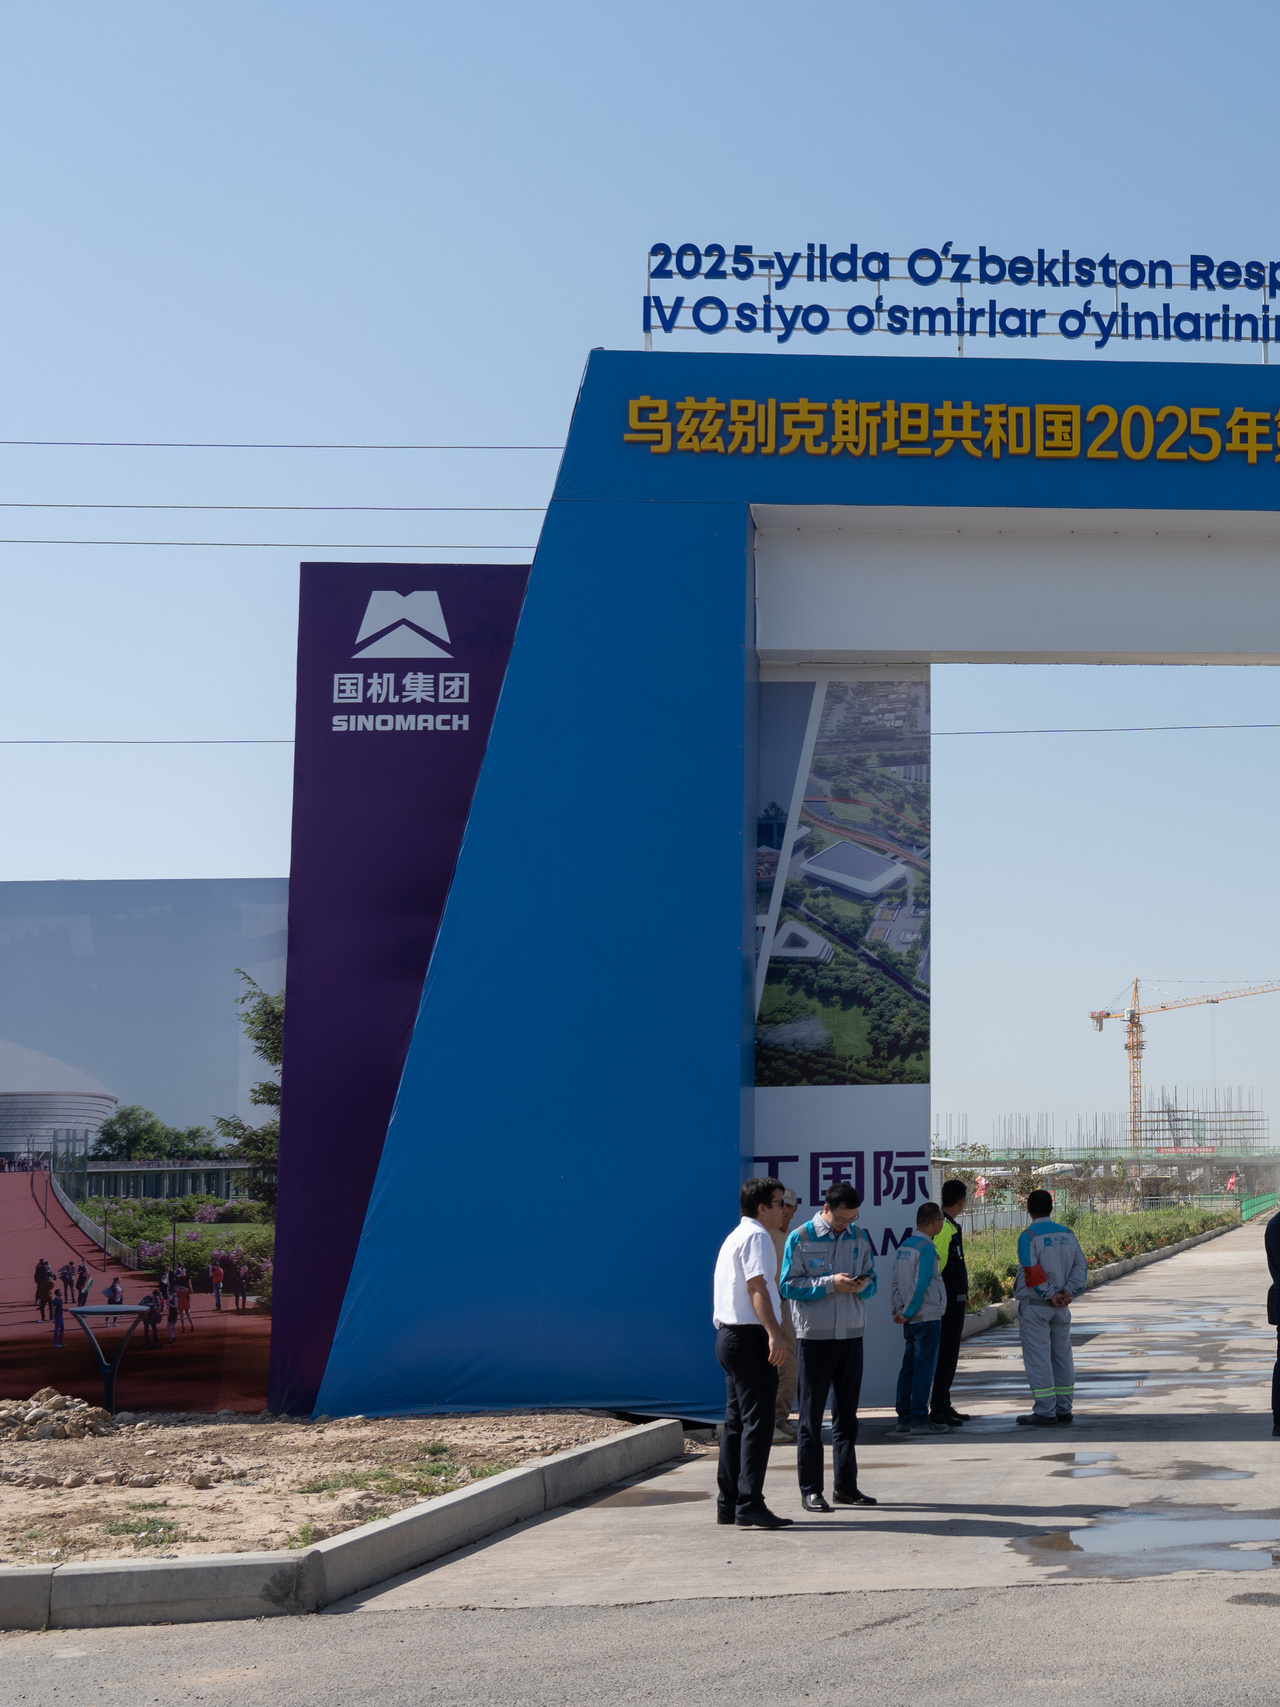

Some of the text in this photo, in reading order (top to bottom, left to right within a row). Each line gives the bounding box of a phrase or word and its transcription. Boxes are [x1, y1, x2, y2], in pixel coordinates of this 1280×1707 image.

[649, 242, 890, 292] 2025-yilda
[643, 295, 685, 333] IV
[692, 295, 830, 343] Osiyo
[333, 672, 470, 704] 国机集团
[332, 714, 470, 732] SINOMACH
